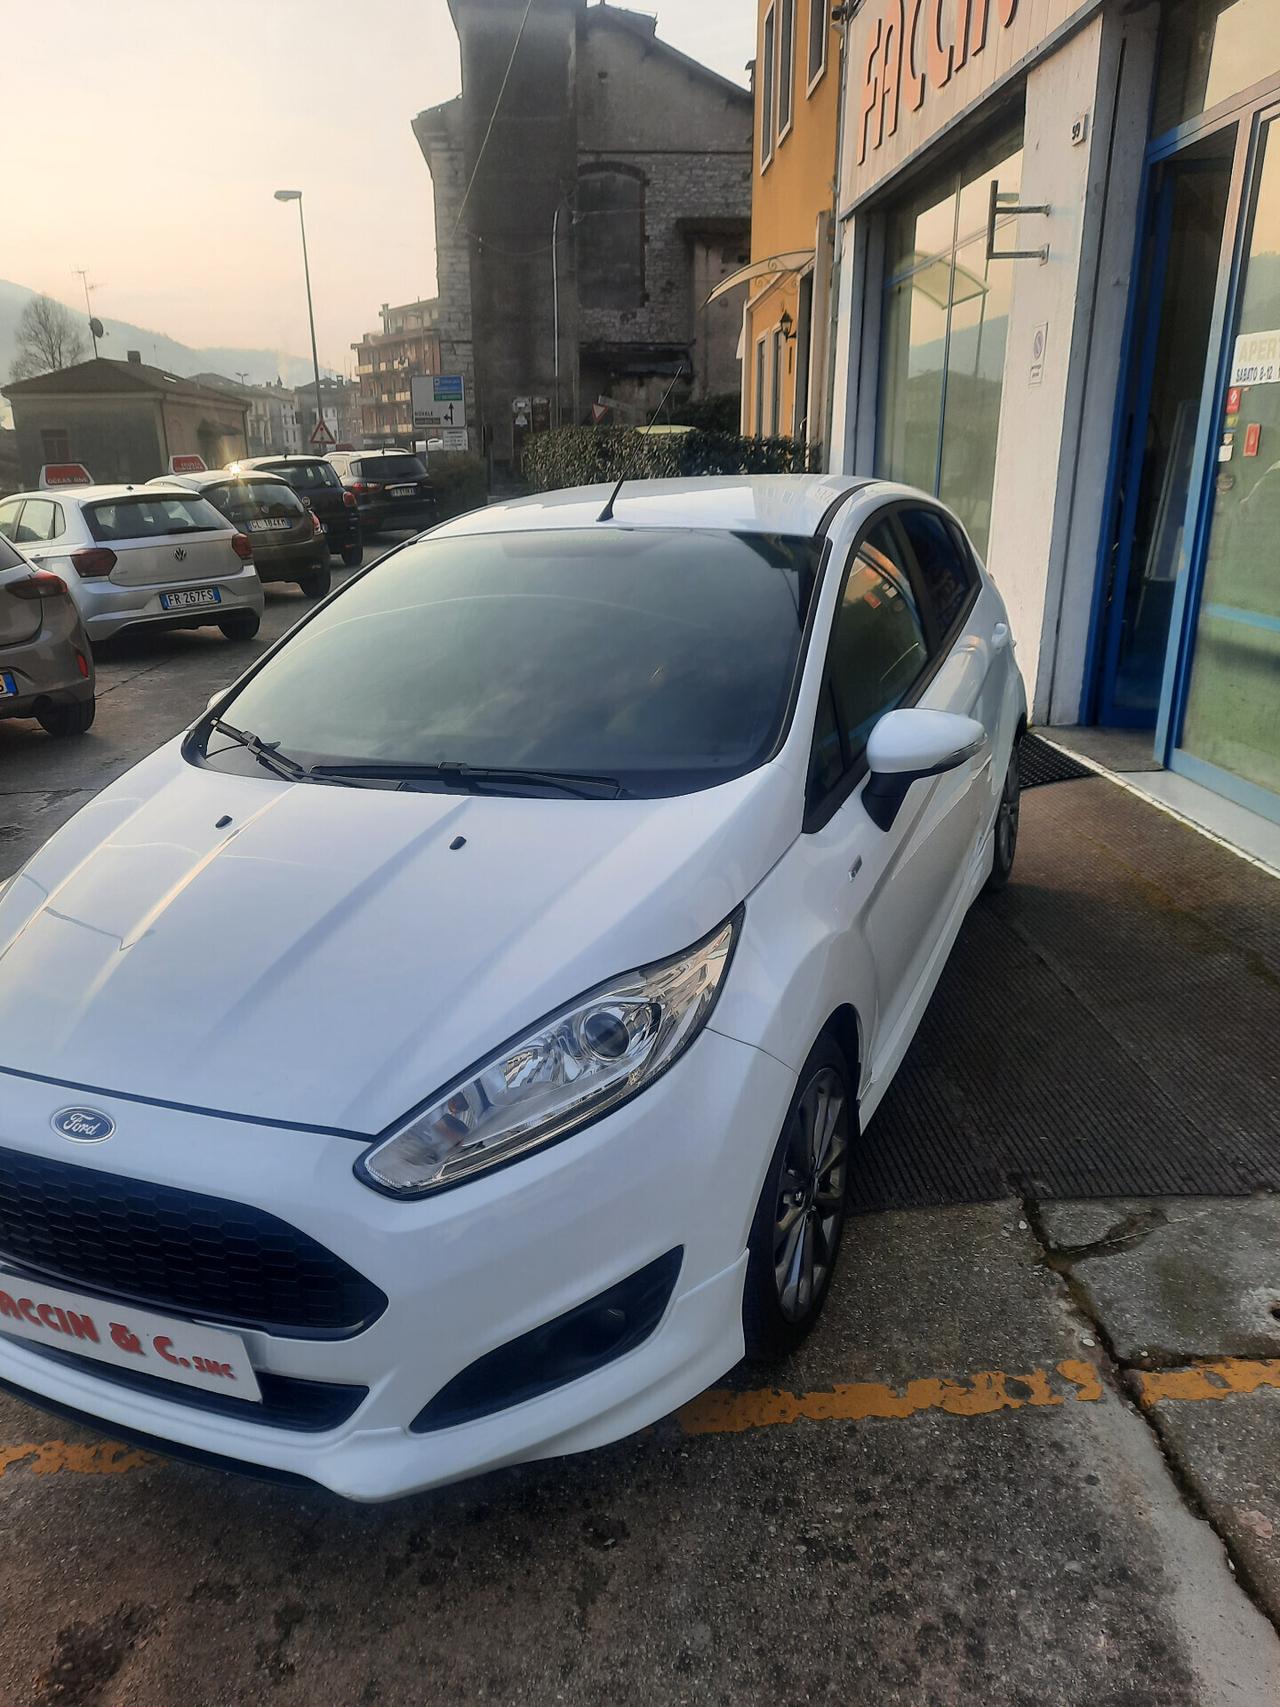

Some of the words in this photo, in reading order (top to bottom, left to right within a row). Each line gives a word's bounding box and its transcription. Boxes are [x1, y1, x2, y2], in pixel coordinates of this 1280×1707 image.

[167, 593, 182, 605] FR
[184, 590, 214, 604] 267FS
[63, 1113, 101, 1135] Ford
[109, 1322, 146, 1356] &
